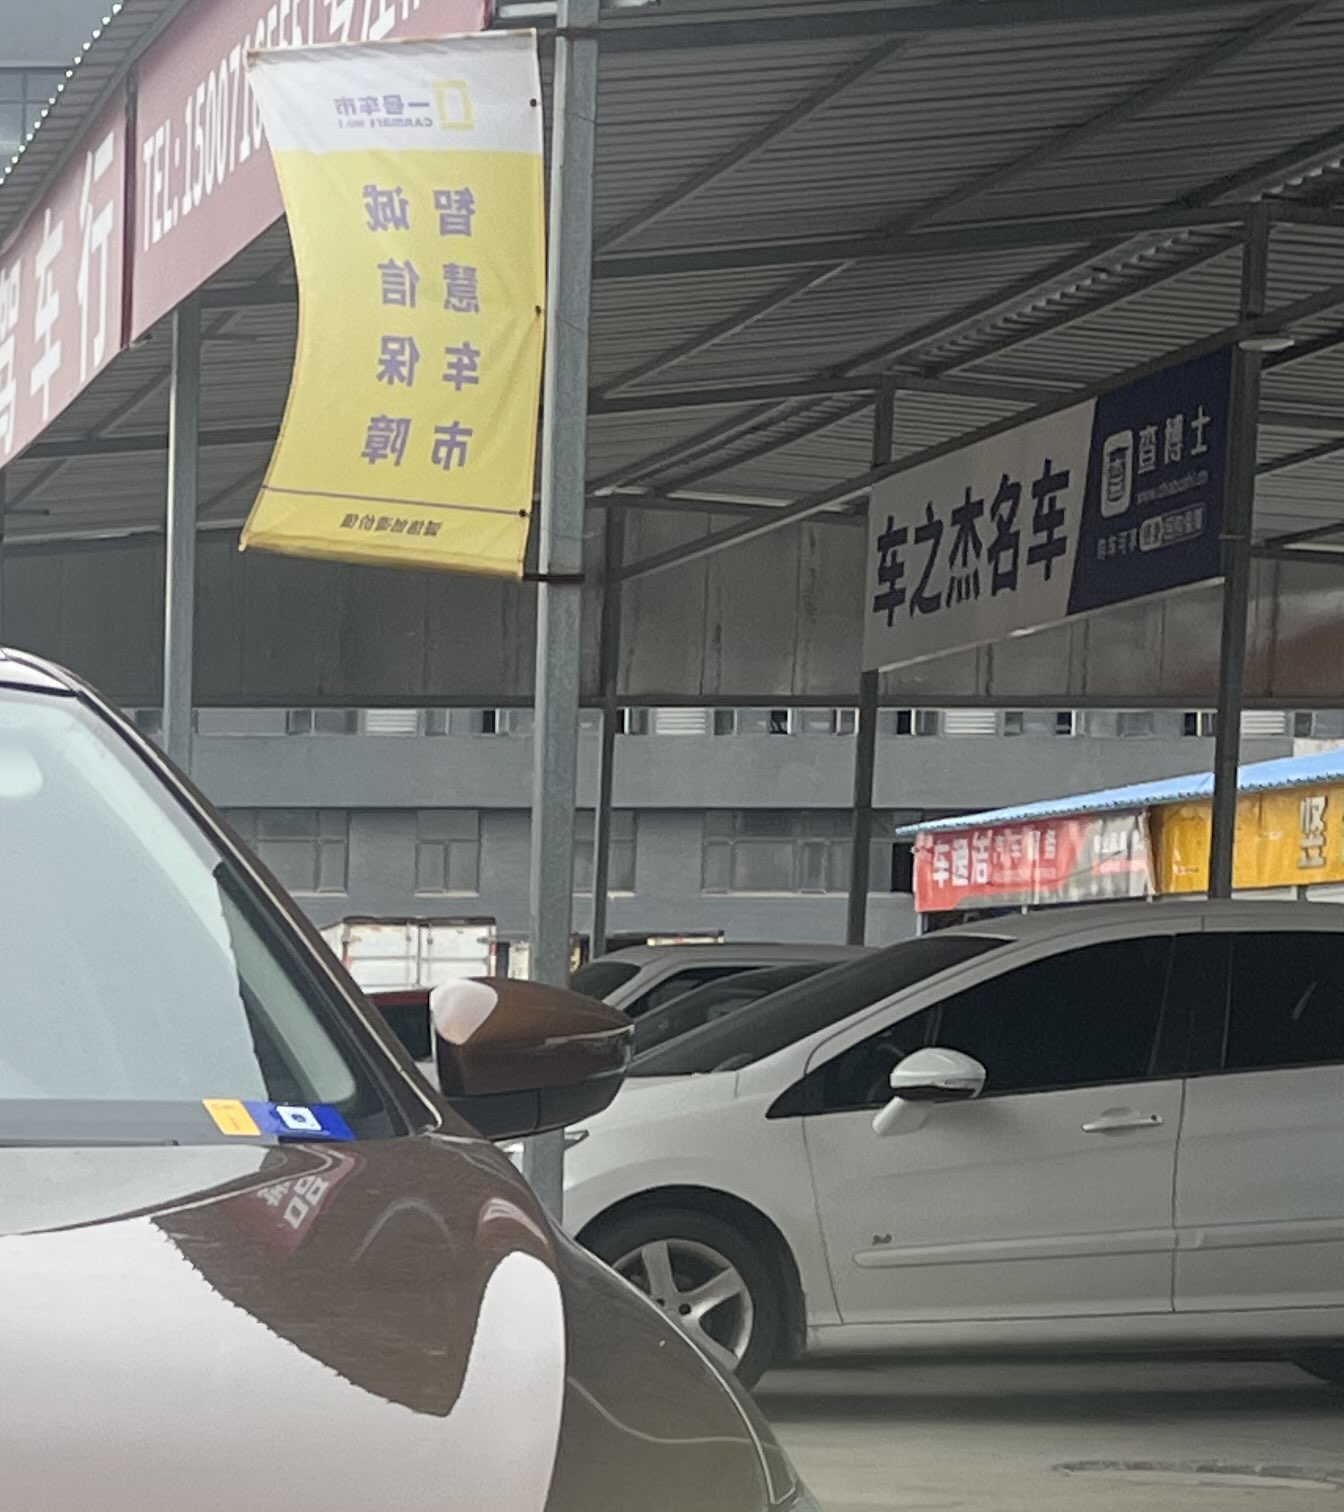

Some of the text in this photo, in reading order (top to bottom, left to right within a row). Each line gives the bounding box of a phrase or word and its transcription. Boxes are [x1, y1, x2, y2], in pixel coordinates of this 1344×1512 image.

[1137, 404, 1211, 475] 查博士
[873, 457, 1070, 628] 车之杰名车
